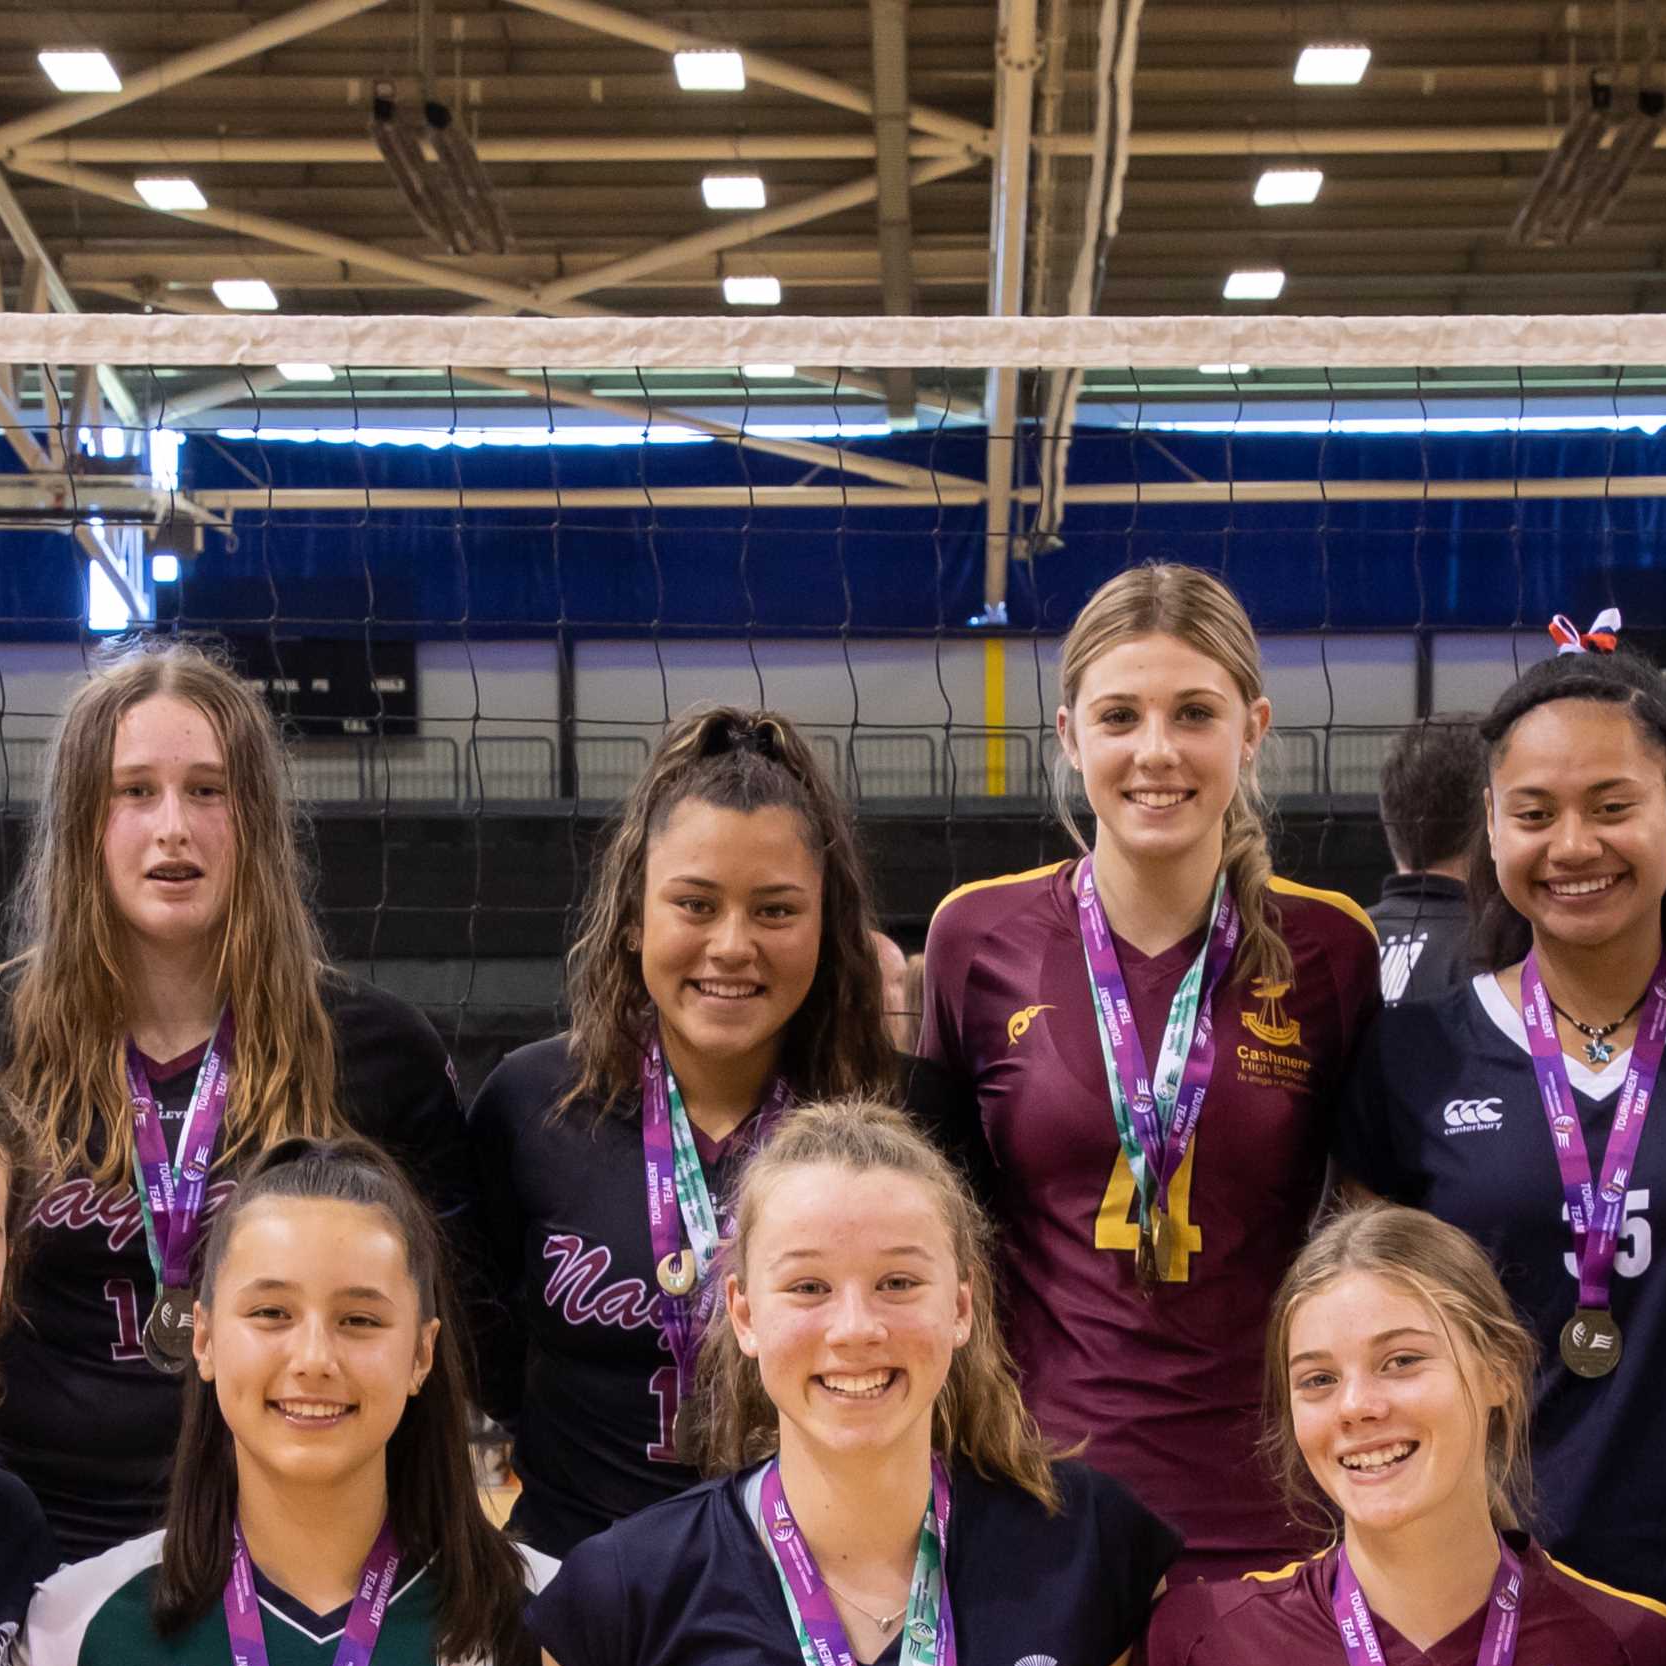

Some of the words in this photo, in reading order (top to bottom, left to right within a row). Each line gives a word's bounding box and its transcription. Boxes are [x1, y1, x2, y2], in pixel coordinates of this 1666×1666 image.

[1116, 998, 1132, 1025] TEAM
[1524, 1003, 1538, 1027] TEAM
[1532, 981, 1555, 1039] TOURNAMENT
[196, 1051, 221, 1111] TOURNAMENT
[215, 1073, 229, 1098] TEAM
[1615, 1068, 1639, 1132] TOURNAMENT
[1633, 1089, 1648, 1116] TEAM
[1173, 1104, 1186, 1131] TEAM
[1444, 1120, 1504, 1136] canterbury
[647, 1161, 662, 1226] TOURNAMENT
[664, 1177, 673, 1204] TEAM
[1095, 1131, 1202, 1282] 4
[362, 1570, 378, 1600] TEAM
[369, 1556, 398, 1628] TOURNAMENT
[1342, 1616, 1361, 1649] TEAM
[1349, 1589, 1382, 1664] TOURNAMENT
